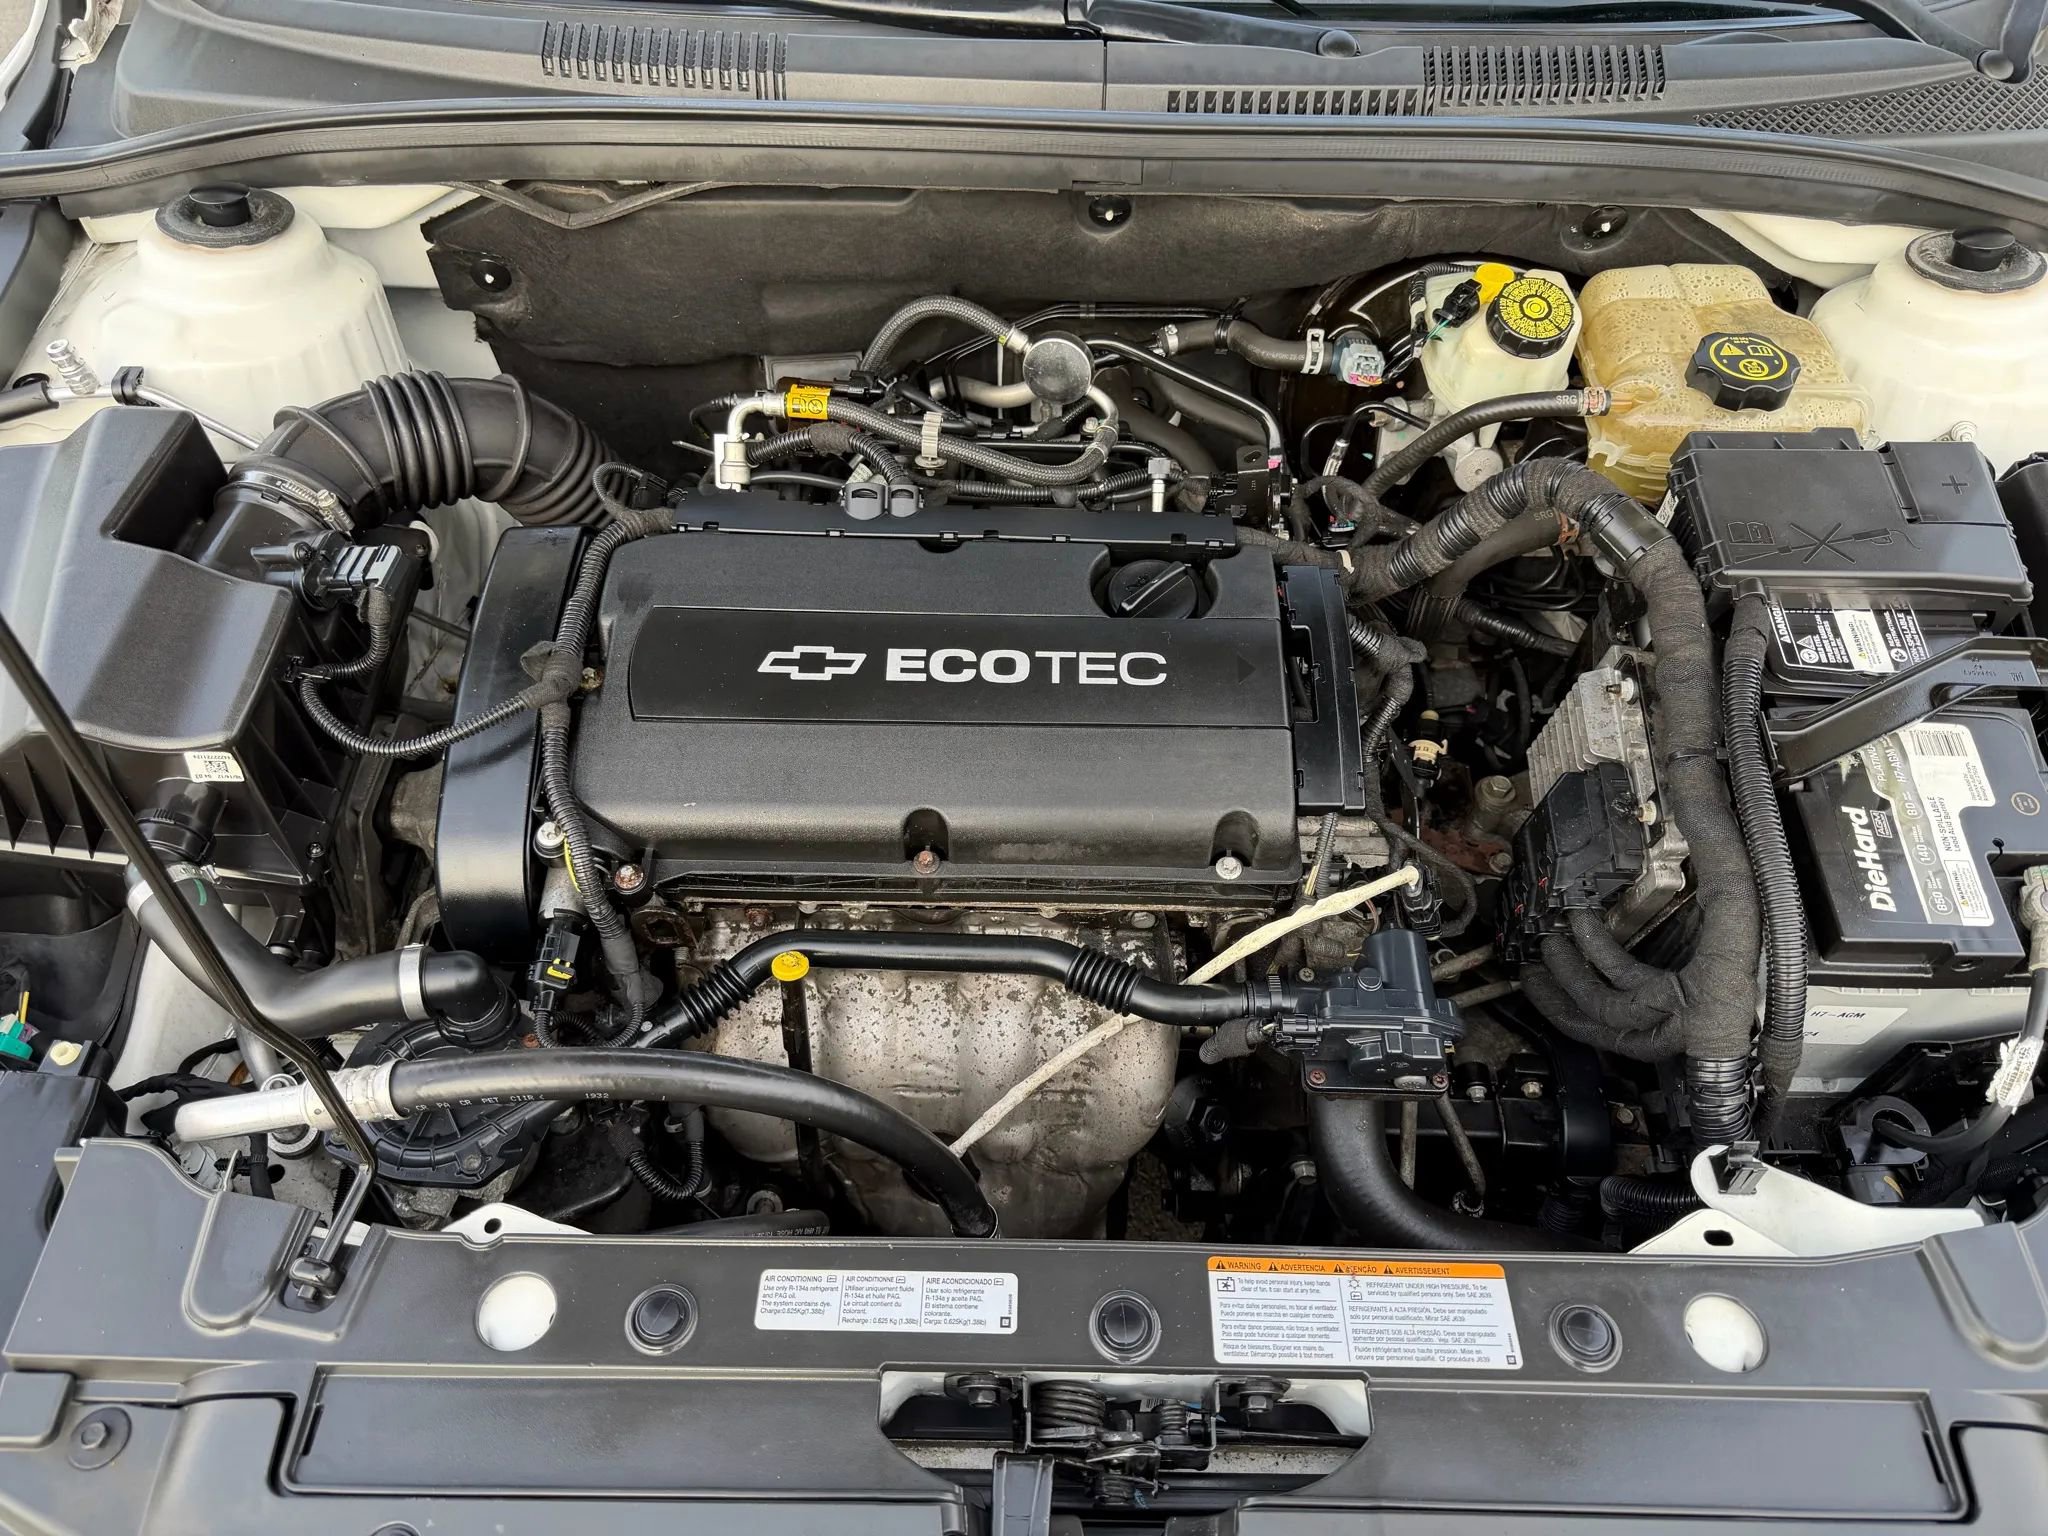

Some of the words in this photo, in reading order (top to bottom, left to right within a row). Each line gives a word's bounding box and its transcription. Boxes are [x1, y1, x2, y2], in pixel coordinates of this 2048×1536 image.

[1556, 396, 1577, 404] SRG
[1534, 508, 1554, 521] SRG
[1907, 615, 1918, 633] Battery
[1885, 633, 1895, 647] READ
[1897, 612, 1920, 663] NON-SPILLABLE
[1912, 633, 1921, 647] Acid
[1916, 646, 1927, 660] Lead
[886, 648, 1167, 686] ECOTEC
[1886, 748, 1906, 782] H7-AGM
[1905, 802, 1918, 816] 80
[1938, 797, 1951, 820] Battery
[1873, 812, 1886, 835] AGM
[1927, 796, 1952, 852] NON-SPILLABLE
[1952, 836, 1961, 852] Lead
[1841, 806, 1897, 912] DieHard
[1917, 844, 1930, 862] 140
[1932, 892, 1948, 911] 850
[416, 1104, 428, 1112] CR
[1228, 1262, 1262, 1270] WARNING
[1280, 1264, 1325, 1272] ADVERTENCIA
[1395, 1267, 1450, 1275] AVERTISSEMENT
[1366, 1282, 1405, 1290] REFRIGERANT
